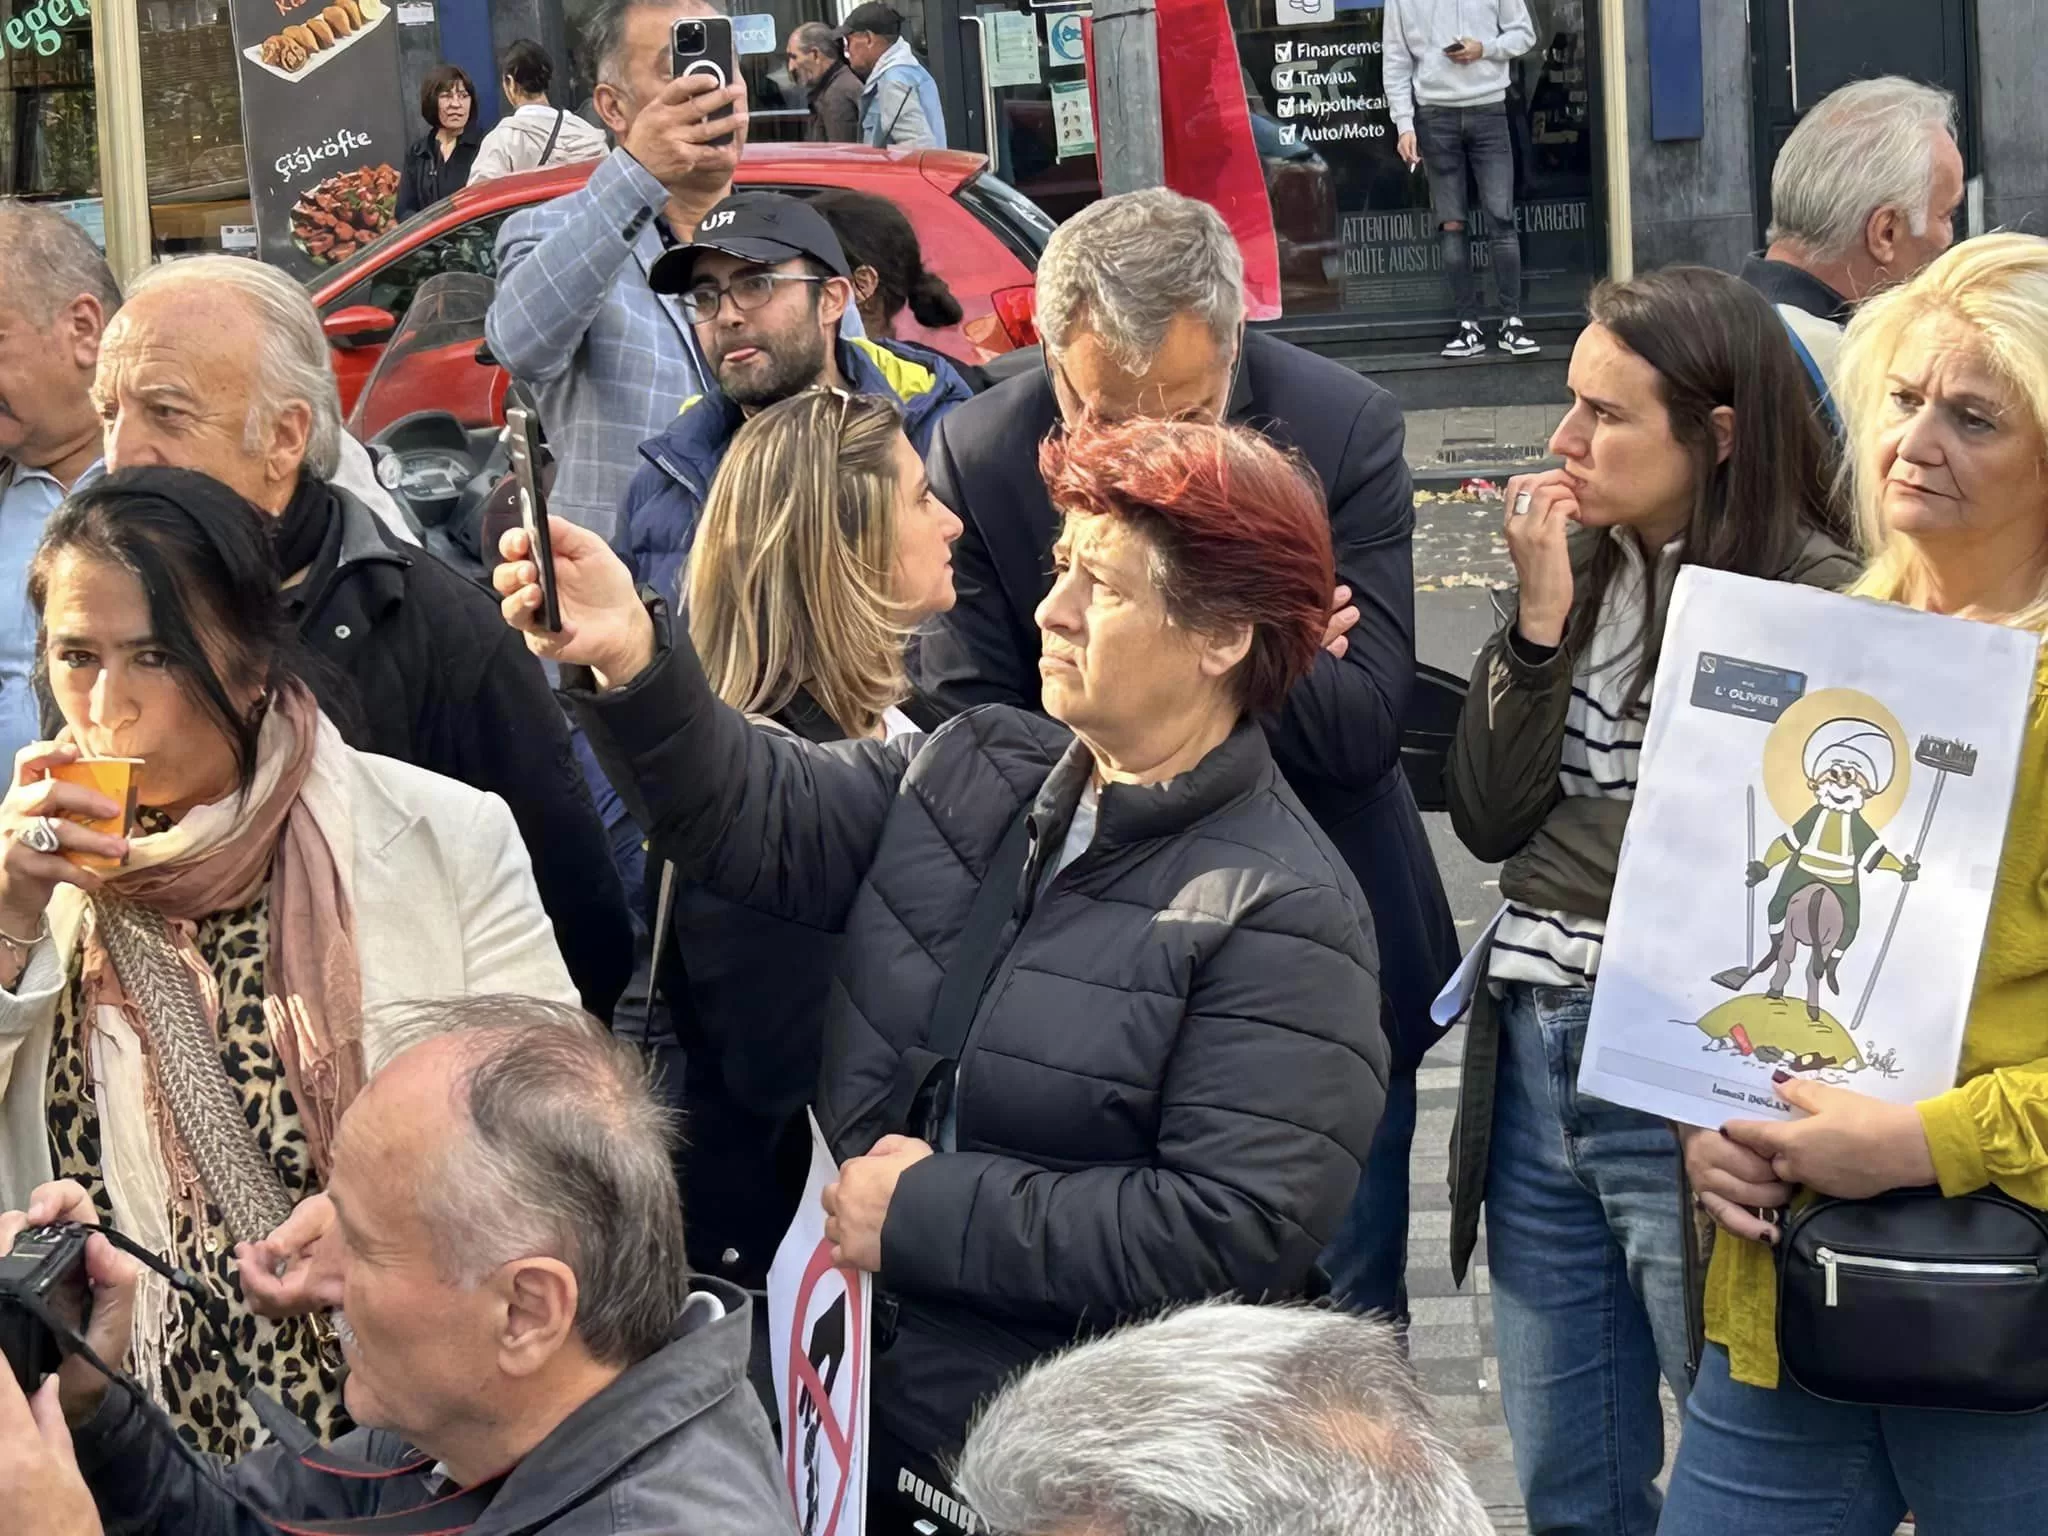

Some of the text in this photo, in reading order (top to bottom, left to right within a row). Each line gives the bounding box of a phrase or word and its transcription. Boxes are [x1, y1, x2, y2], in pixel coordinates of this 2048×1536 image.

[1297, 41, 1382, 58] Financeme
[1298, 70, 1357, 86] Travaux
[1301, 123, 1385, 142] Auto/Moto
[1525, 202, 1587, 233] L'ARGENT
[1344, 244, 1385, 275] COÛTE
[1389, 245, 1428, 273] AUSSI
[897, 1466, 978, 1536] PUMA
